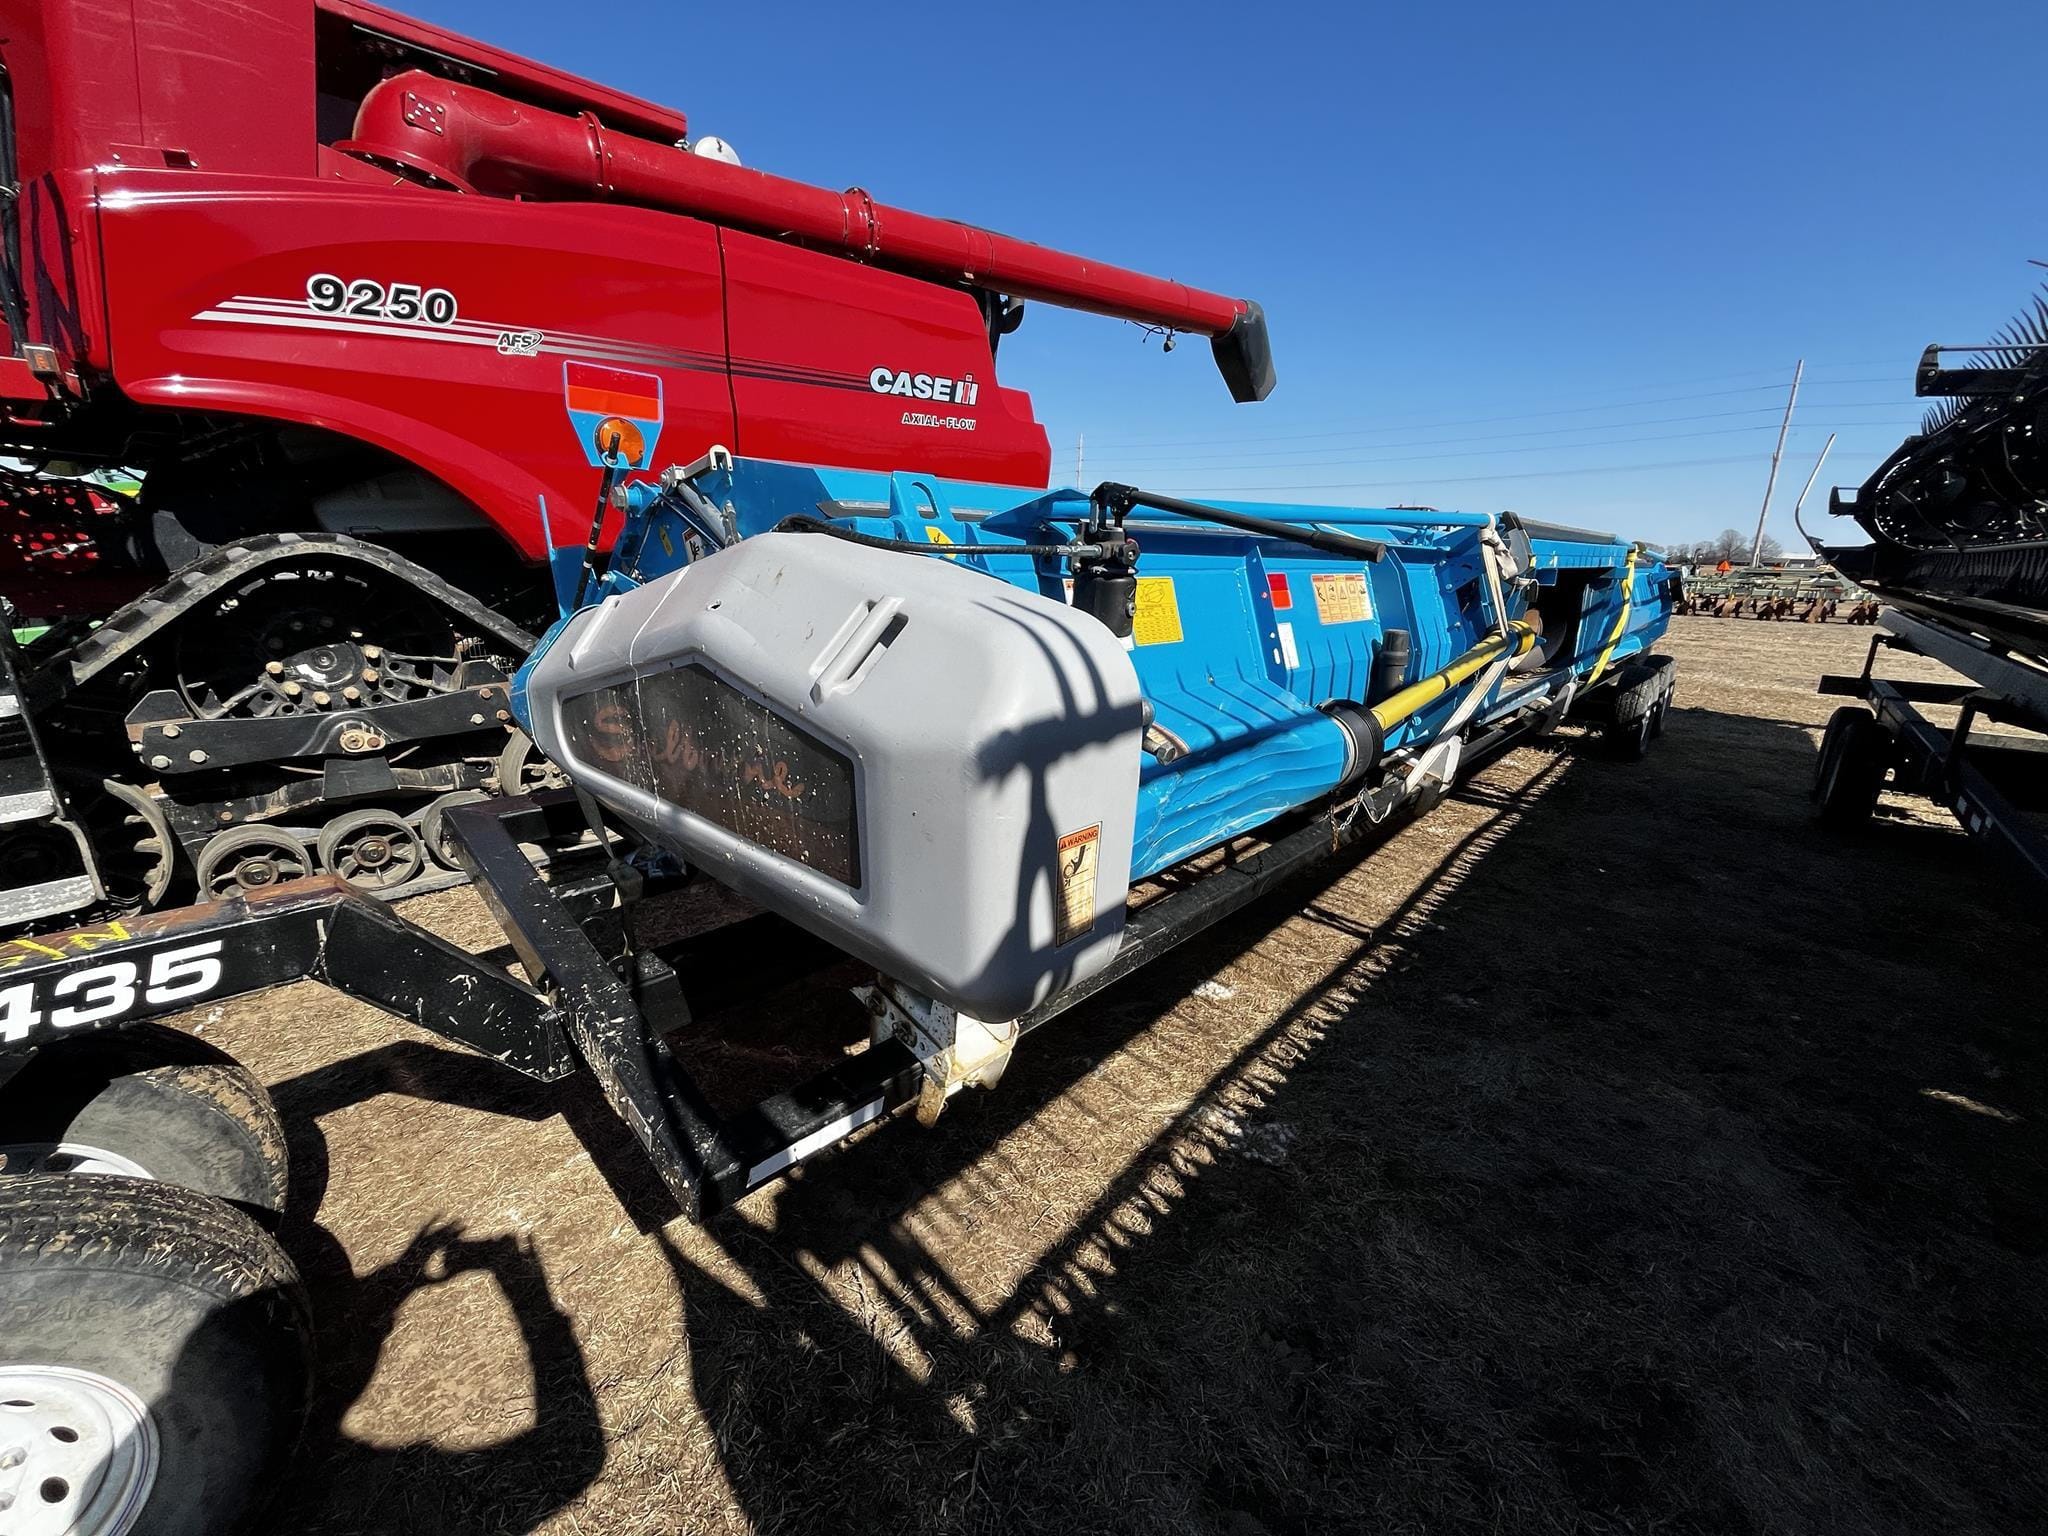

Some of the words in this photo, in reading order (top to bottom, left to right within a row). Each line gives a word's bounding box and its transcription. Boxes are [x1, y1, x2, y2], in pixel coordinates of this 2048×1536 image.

[307, 274, 457, 326] 9250
[498, 332, 533, 348] AFS
[869, 367, 953, 402] CASE
[902, 412, 976, 431] AXIAL-FLOW
[1066, 829, 1098, 848] WARNING
[0, 939, 224, 1043] 435
